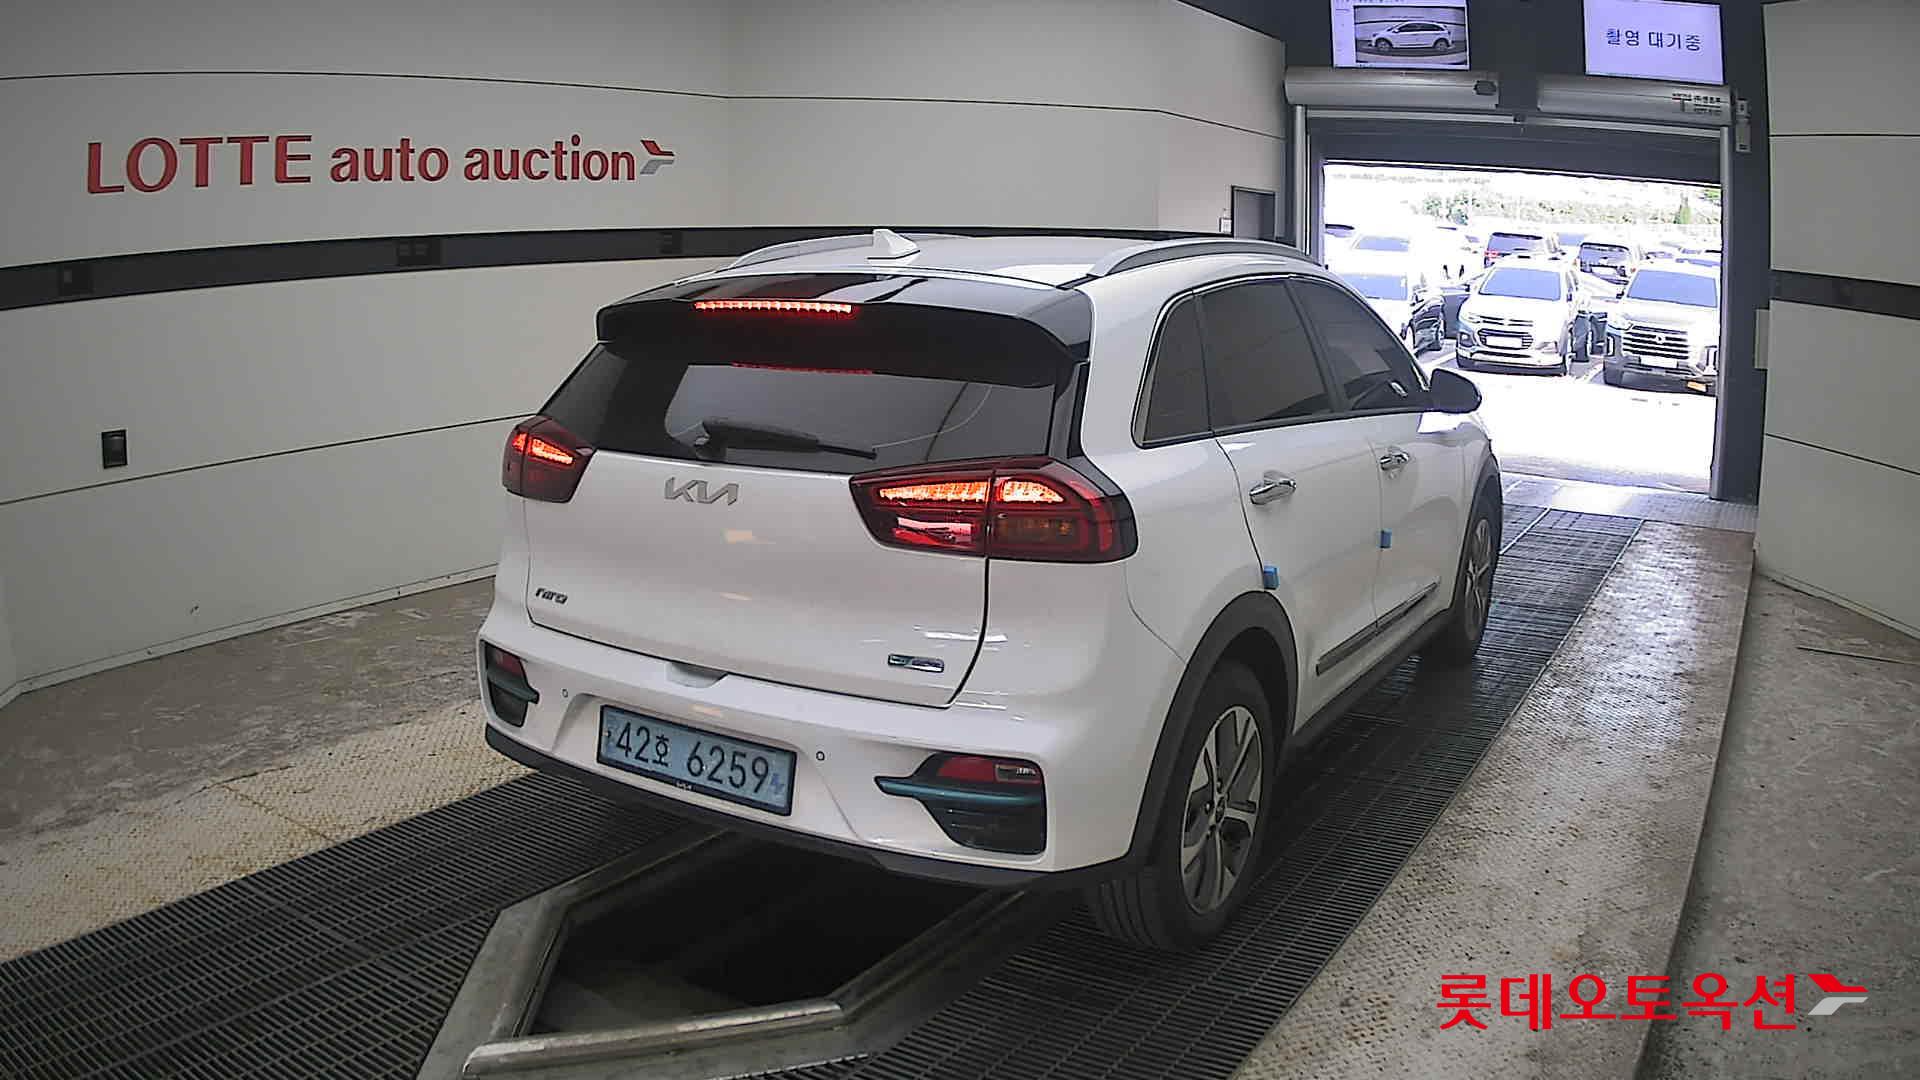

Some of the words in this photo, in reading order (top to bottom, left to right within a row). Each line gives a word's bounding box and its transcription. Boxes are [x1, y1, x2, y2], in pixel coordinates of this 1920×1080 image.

[1647, 31, 1701, 52] 대기중
[87, 134, 312, 194] LOTTE
[329, 137, 450, 183] auto
[463, 133, 636, 182] auction
[615, 721, 670, 768] 42호
[686, 741, 770, 794] 6259
